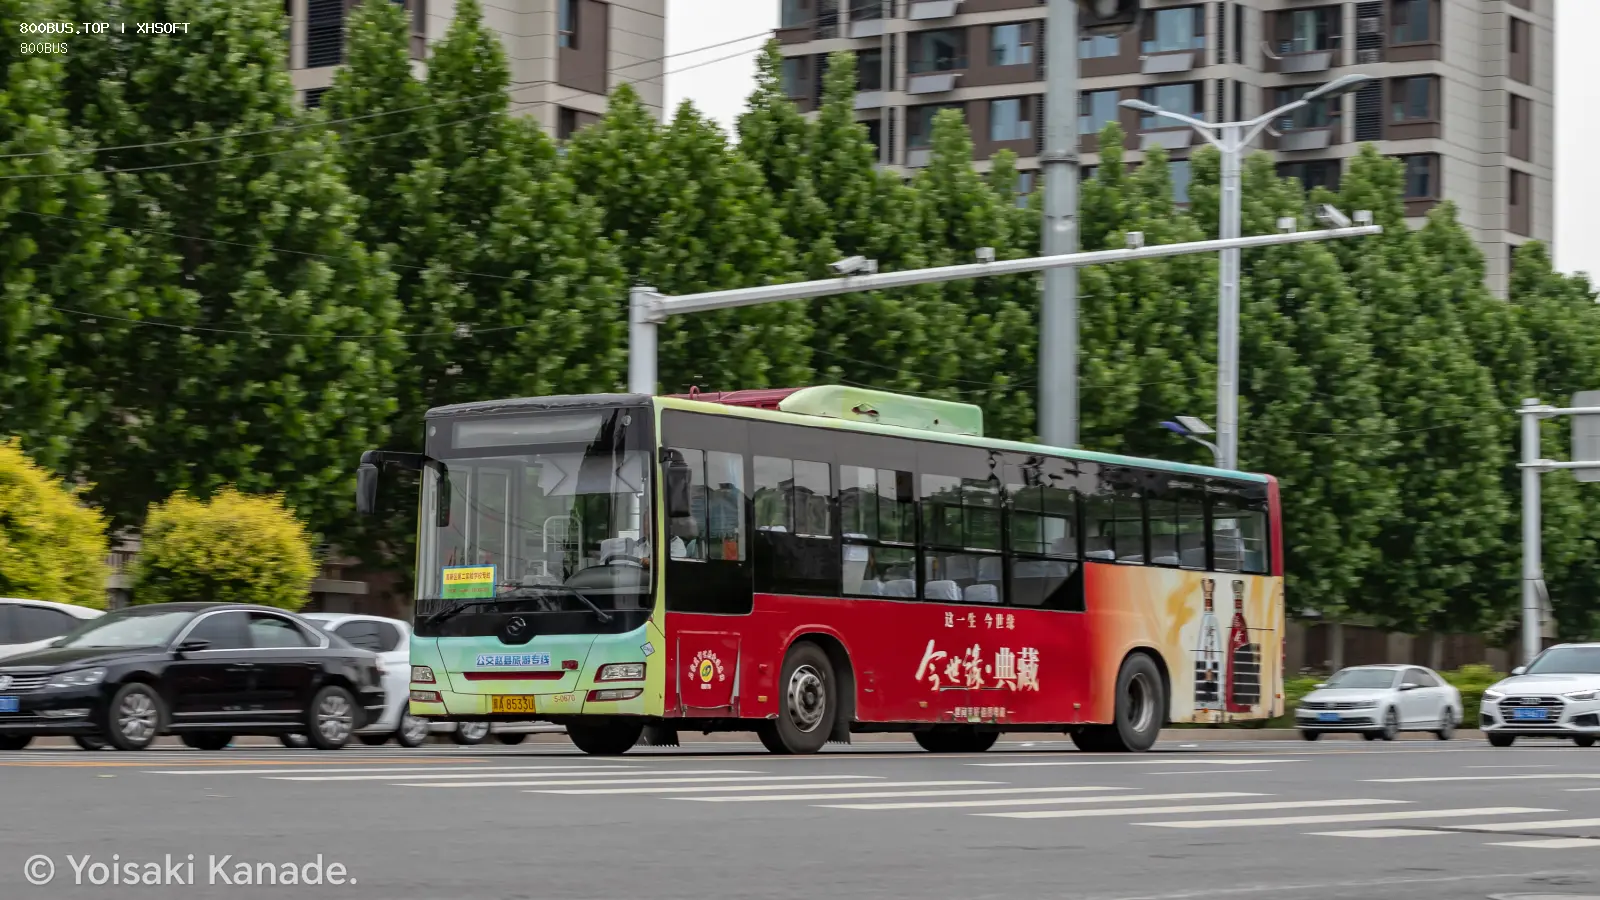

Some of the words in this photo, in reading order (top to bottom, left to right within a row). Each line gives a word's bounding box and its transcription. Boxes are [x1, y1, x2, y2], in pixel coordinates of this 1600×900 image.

[944, 611, 977, 628] 这一生
[476, 653, 550, 666] 公交赵县旅游专线
